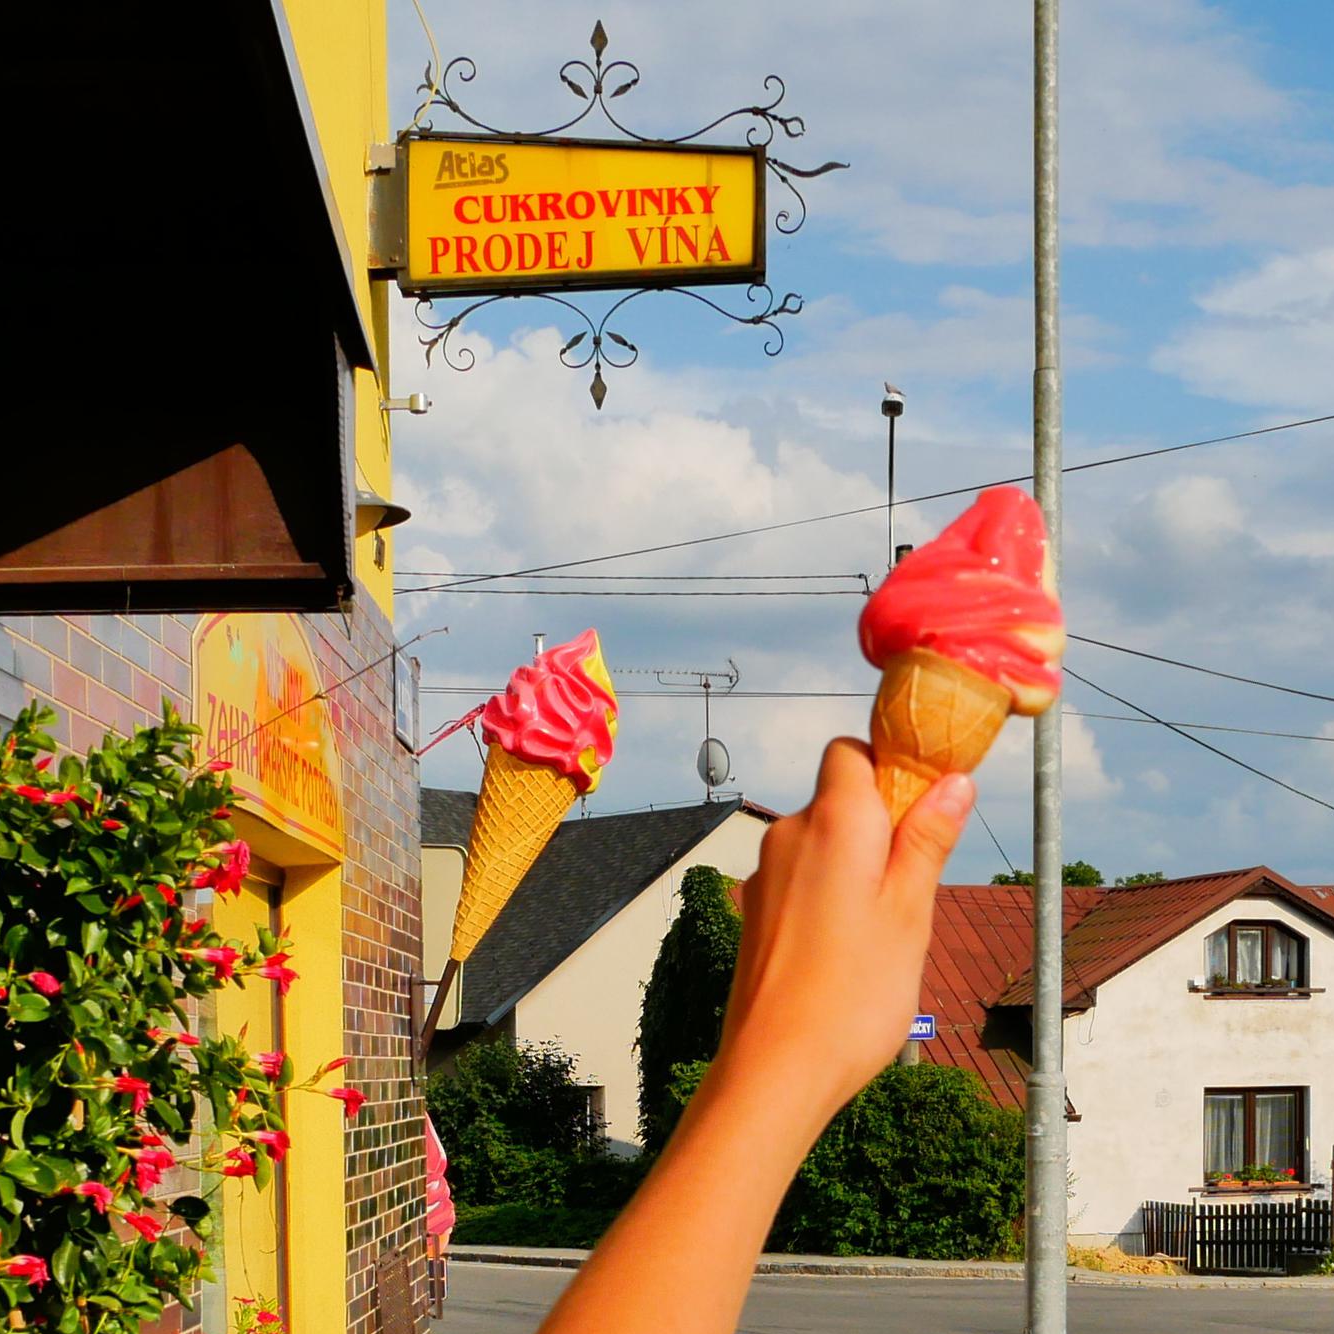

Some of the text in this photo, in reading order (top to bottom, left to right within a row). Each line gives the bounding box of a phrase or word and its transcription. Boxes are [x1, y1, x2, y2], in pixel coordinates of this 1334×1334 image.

[435, 149, 509, 185] Atlas
[453, 186, 721, 225] CUKROVINKY
[427, 215, 732, 275] PRODEJ VÍNA
